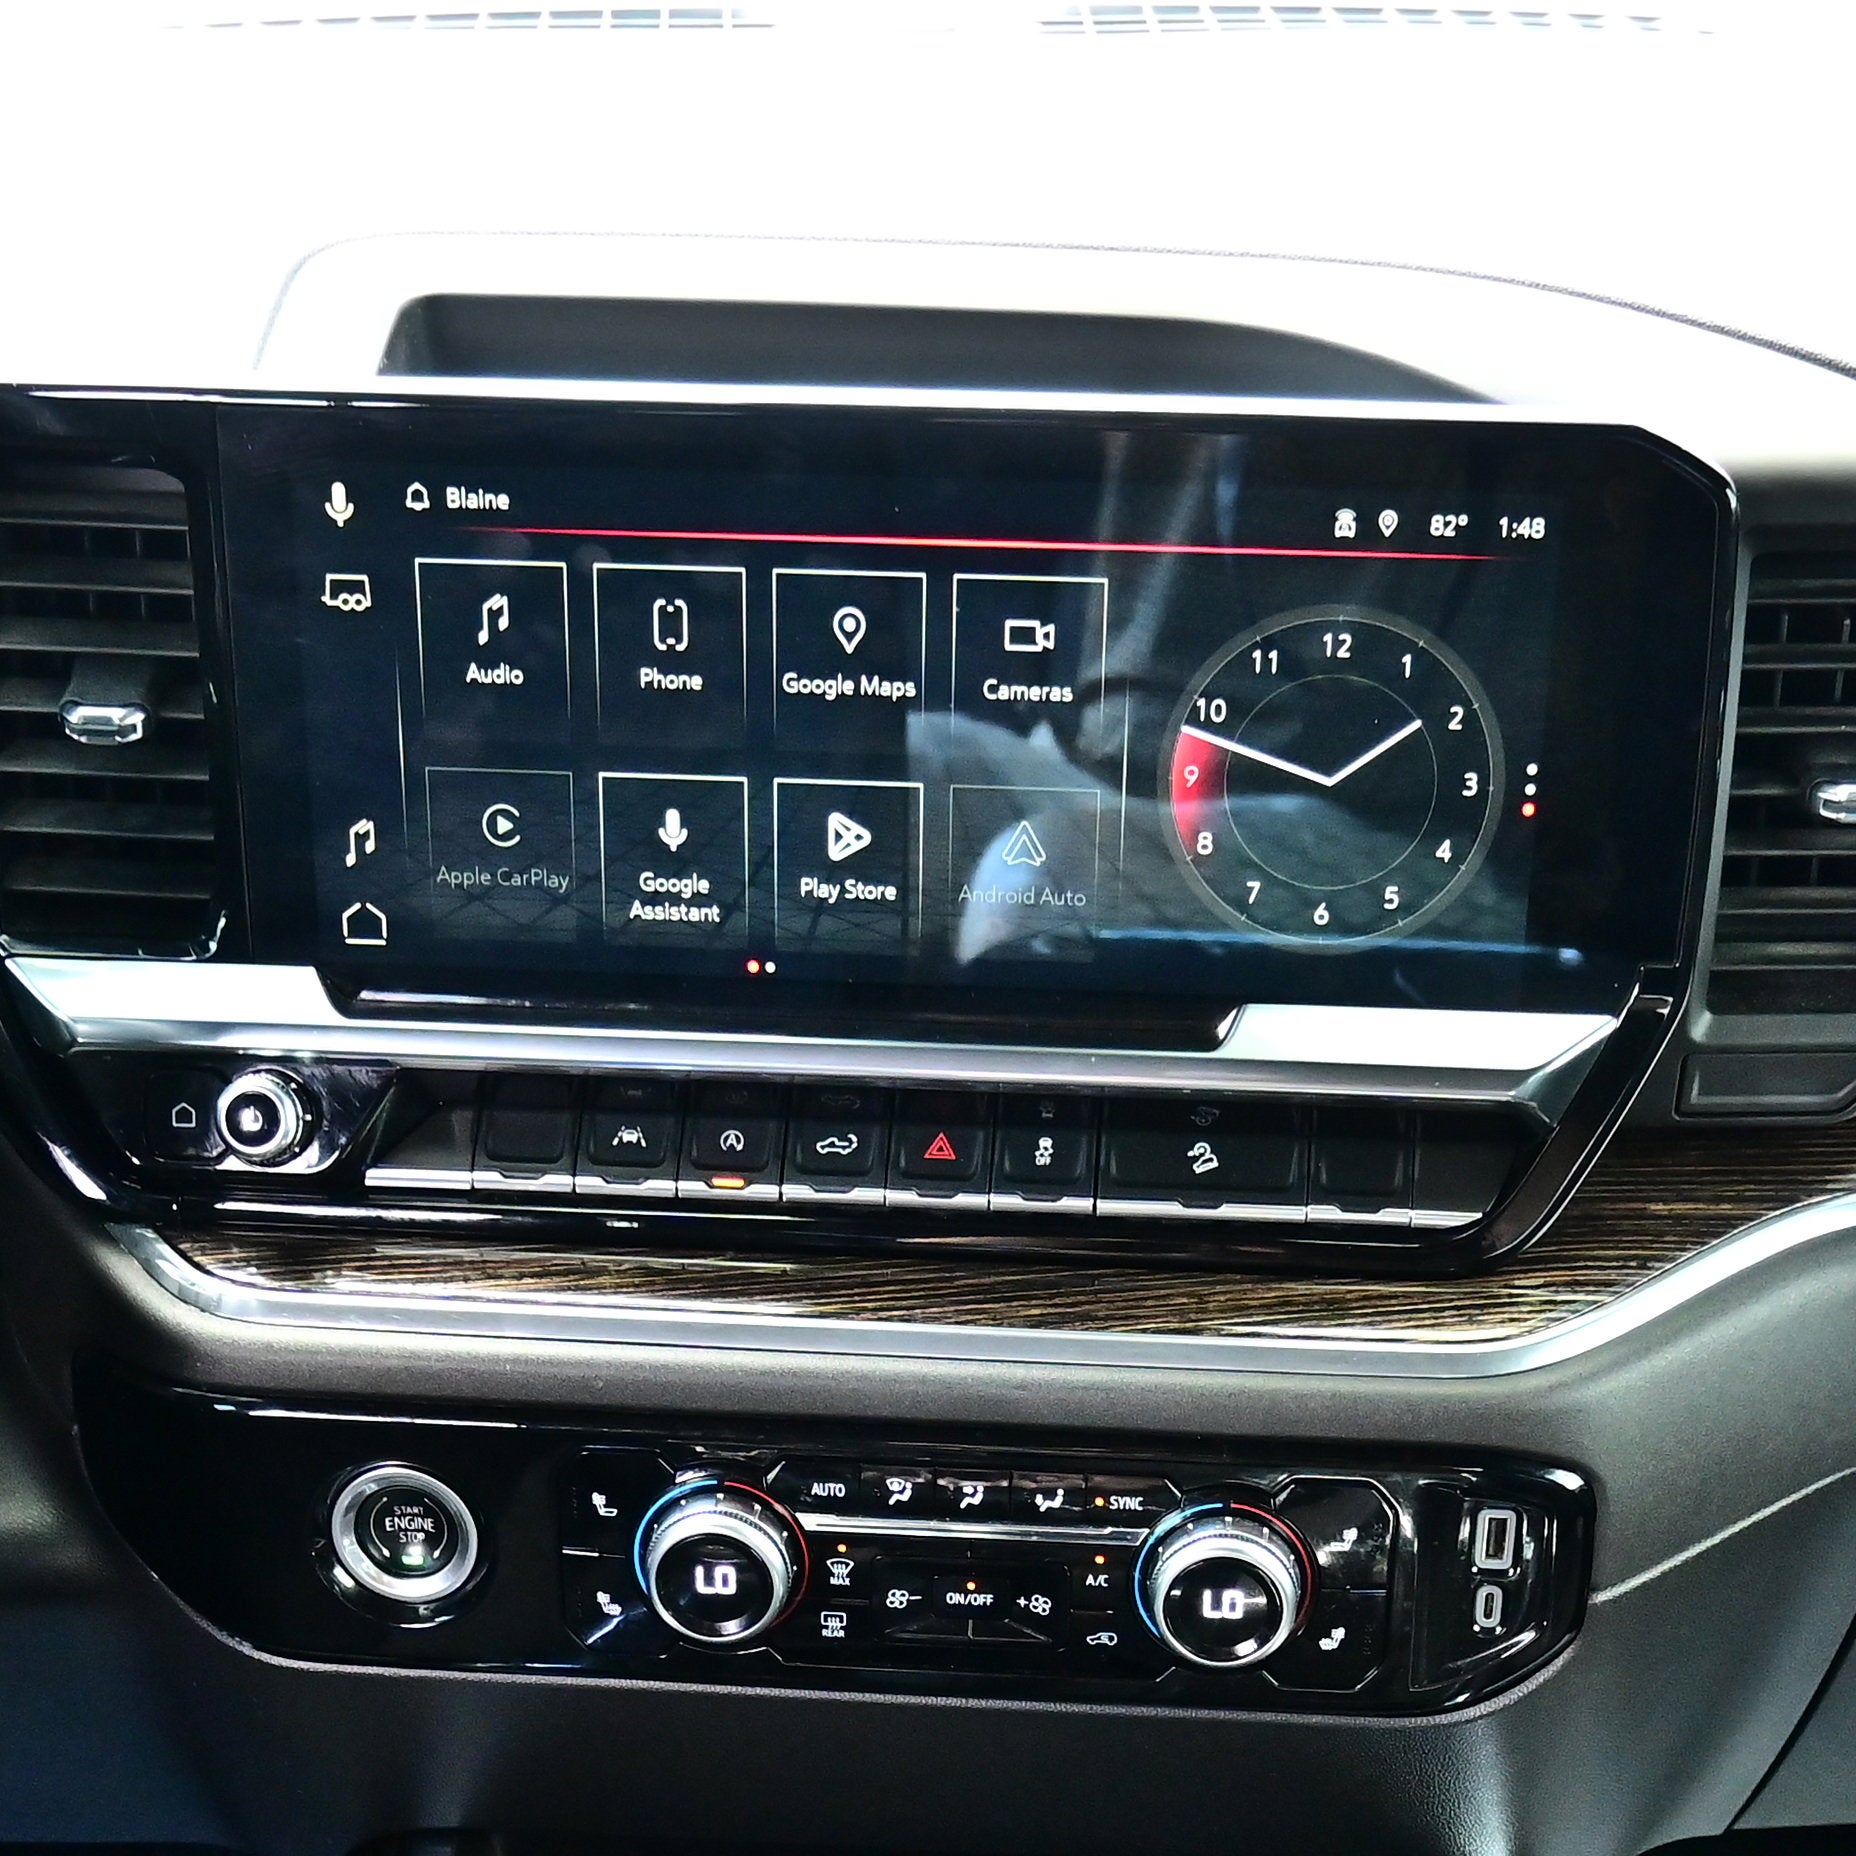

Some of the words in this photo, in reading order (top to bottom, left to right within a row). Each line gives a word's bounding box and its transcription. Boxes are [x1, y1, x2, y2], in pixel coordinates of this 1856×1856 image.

[445, 486, 511, 511] Blaine
[1499, 516, 1546, 539] 1:48
[1322, 632, 1353, 660] 12
[1251, 649, 1279, 674] 11
[1401, 653, 1412, 679] 1
[465, 662, 525, 687] Audio
[639, 667, 704, 692] Phone
[782, 672, 855, 700] Google
[860, 675, 917, 703] Maps
[982, 678, 1074, 703] Cameras
[1195, 698, 1227, 723] 10
[1447, 706, 1464, 730] 2
[1183, 765, 1199, 788] 9
[1462, 773, 1478, 796] 3
[1196, 832, 1213, 856] 8
[1435, 839, 1452, 862] 4
[436, 866, 492, 890] Apple
[497, 867, 570, 894] CarPlay
[639, 871, 711, 899] Google
[800, 876, 841, 902] Play
[844, 879, 897, 902] Store
[959, 885, 1035, 906] Android
[1040, 888, 1087, 907] Auto
[1246, 881, 1262, 904] 7
[1383, 886, 1400, 911] 5
[629, 899, 721, 924] Assistant
[1313, 902, 1329, 926] 6
[811, 1483, 846, 1497] AUTO
[393, 1505, 424, 1516] START
[1109, 1496, 1144, 1511] SYNC
[384, 1515, 436, 1533] ENGINE
[399, 1531, 426, 1543] STOP
[694, 1565, 737, 1596] LO
[829, 1575, 851, 1587] MAX
[1085, 1574, 1109, 1588] A/C
[945, 1592, 994, 1607] ON/OFF
[1202, 1588, 1245, 1620] LO
[821, 1627, 845, 1638] REAR
